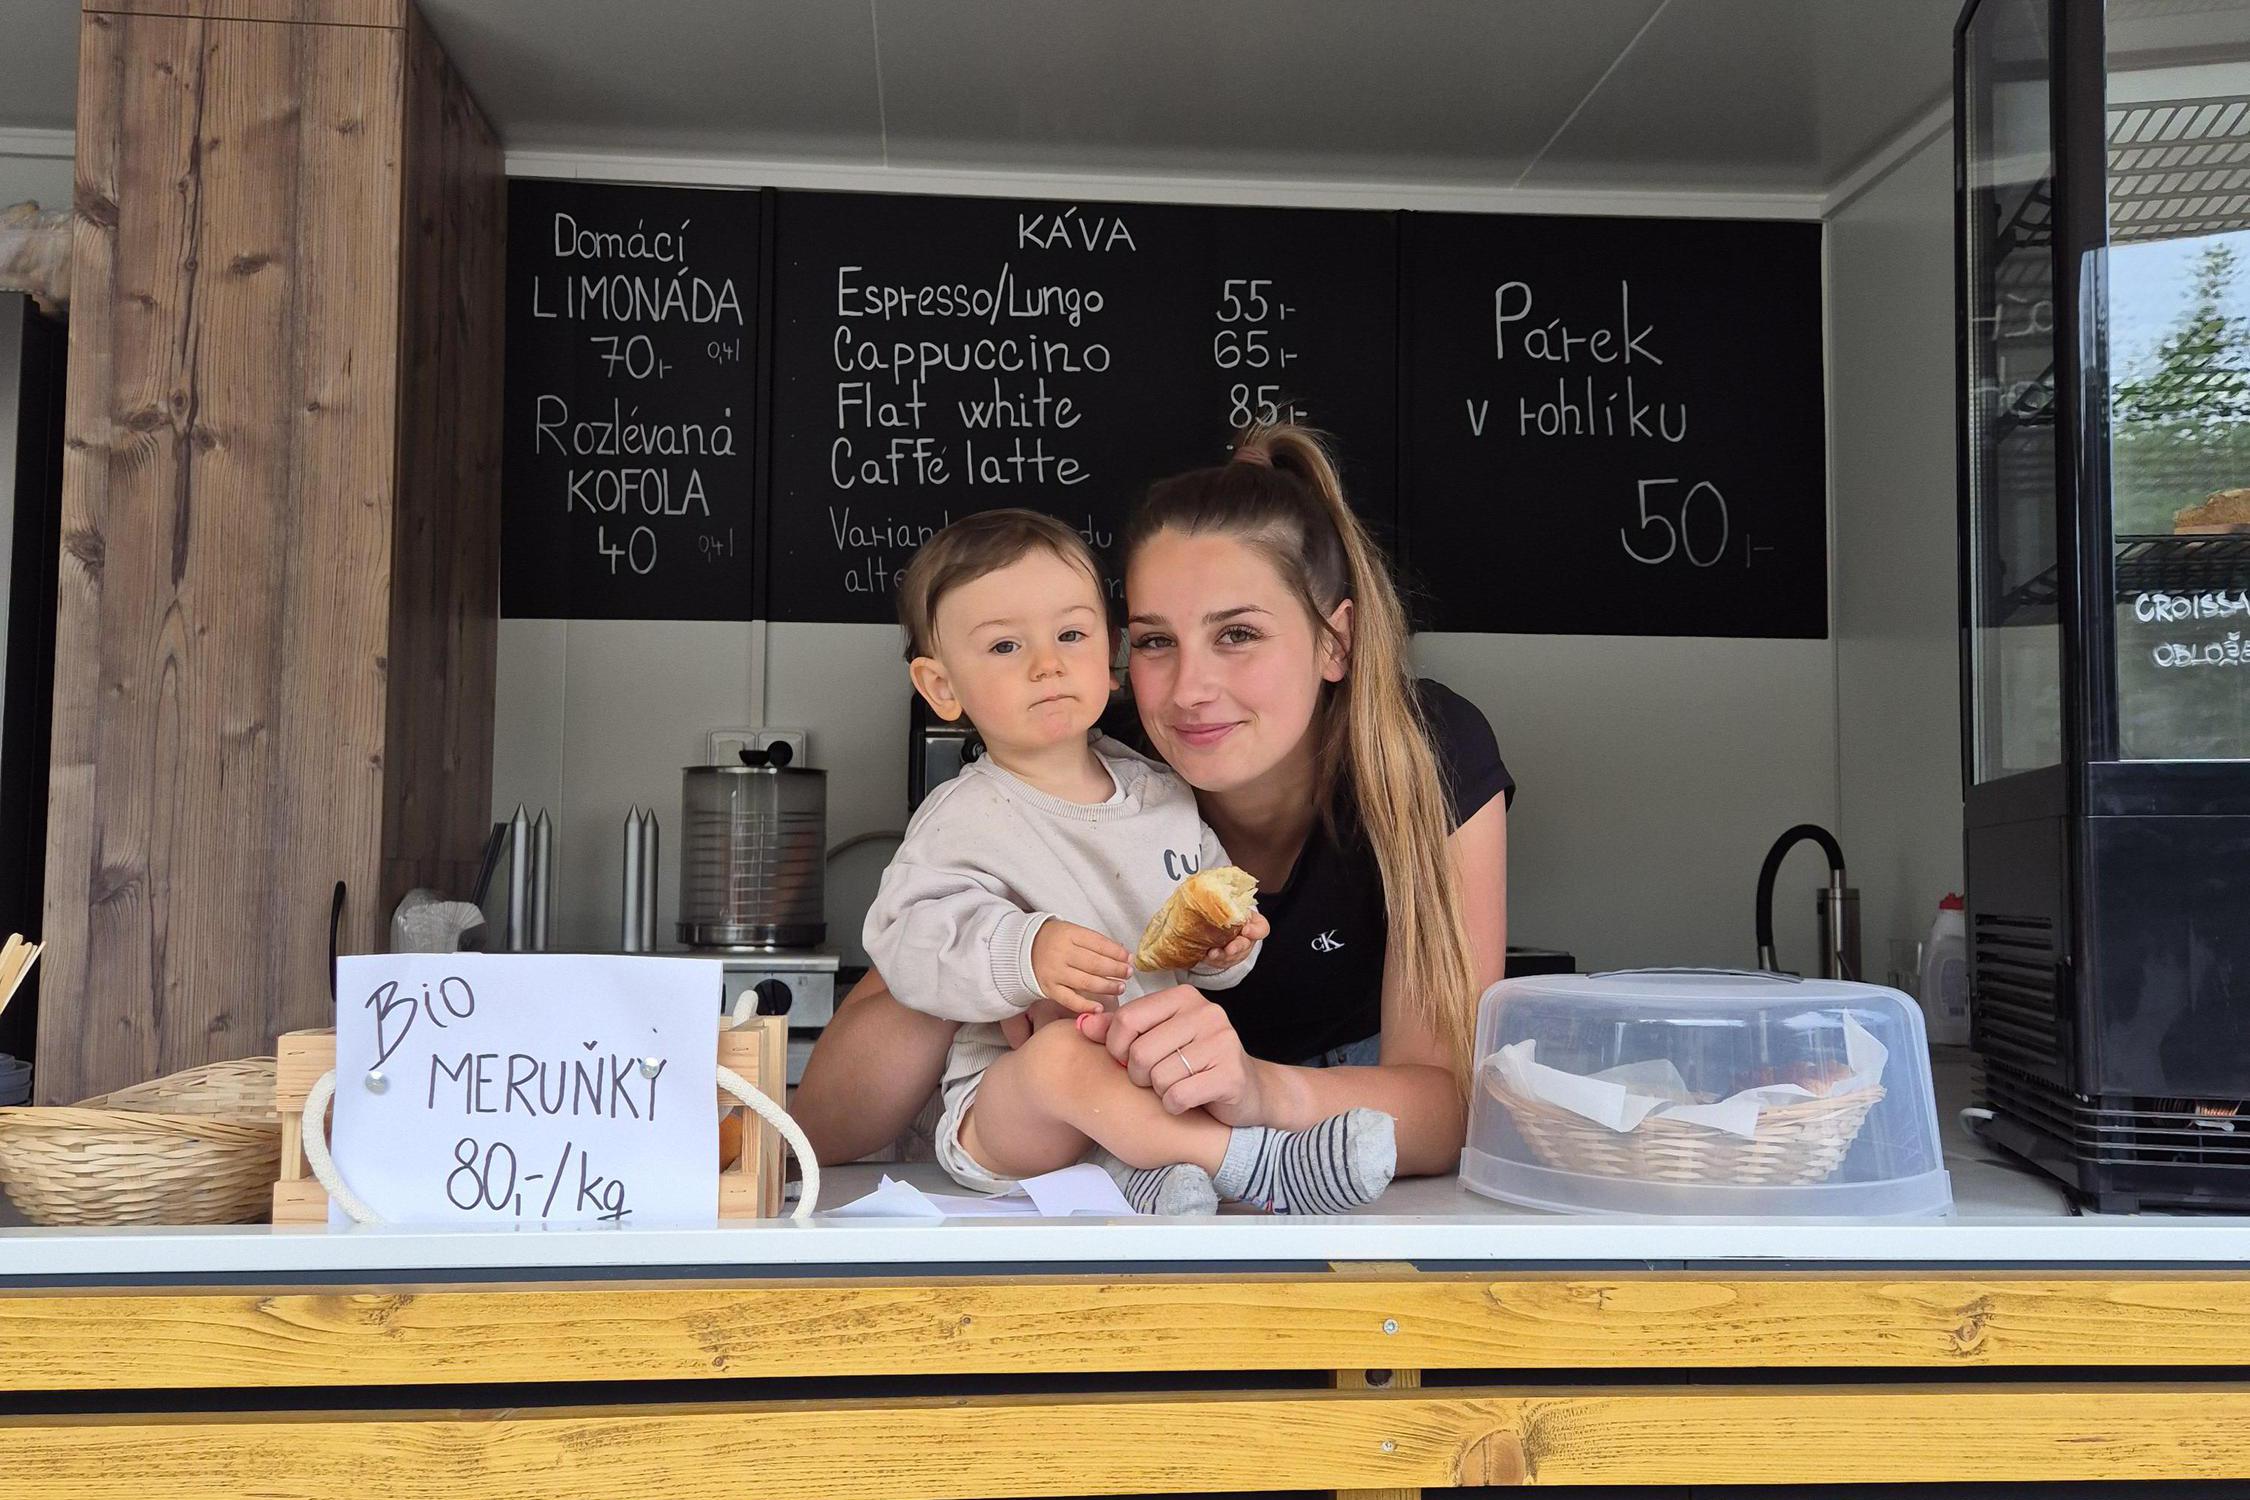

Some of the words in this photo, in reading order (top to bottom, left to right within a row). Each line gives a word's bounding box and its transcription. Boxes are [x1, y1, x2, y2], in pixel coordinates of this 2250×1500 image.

[555, 213, 690, 262] Domácí
[1019, 207, 1136, 251] KÁVA
[534, 267, 743, 325] LIMONÁDA
[839, 263, 1103, 327] Espresso/Lungo
[1217, 280, 1294, 322] 55,-
[1496, 280, 1662, 365] Párek
[591, 335, 672, 379] 70,-
[834, 326, 1110, 385] Cappuccino
[1215, 330, 1297, 368] 65,-
[537, 395, 736, 455] Rozlévaná
[839, 379, 926, 429] Flat
[959, 378, 1081, 428] white
[1467, 399, 1488, 436] v
[1520, 376, 1686, 442] rohlíku
[967, 438, 1089, 484] latte
[568, 468, 709, 516] KOFOLA
[599, 526, 656, 574] 40
[829, 507, 948, 550] Varian
[2135, 590, 2250, 624] CROISSA
[2151, 631, 2250, 668] OBLOŽE
[429, 1041, 666, 1121] MERUŇKY
[447, 1138, 632, 1220] 80,-/kg
